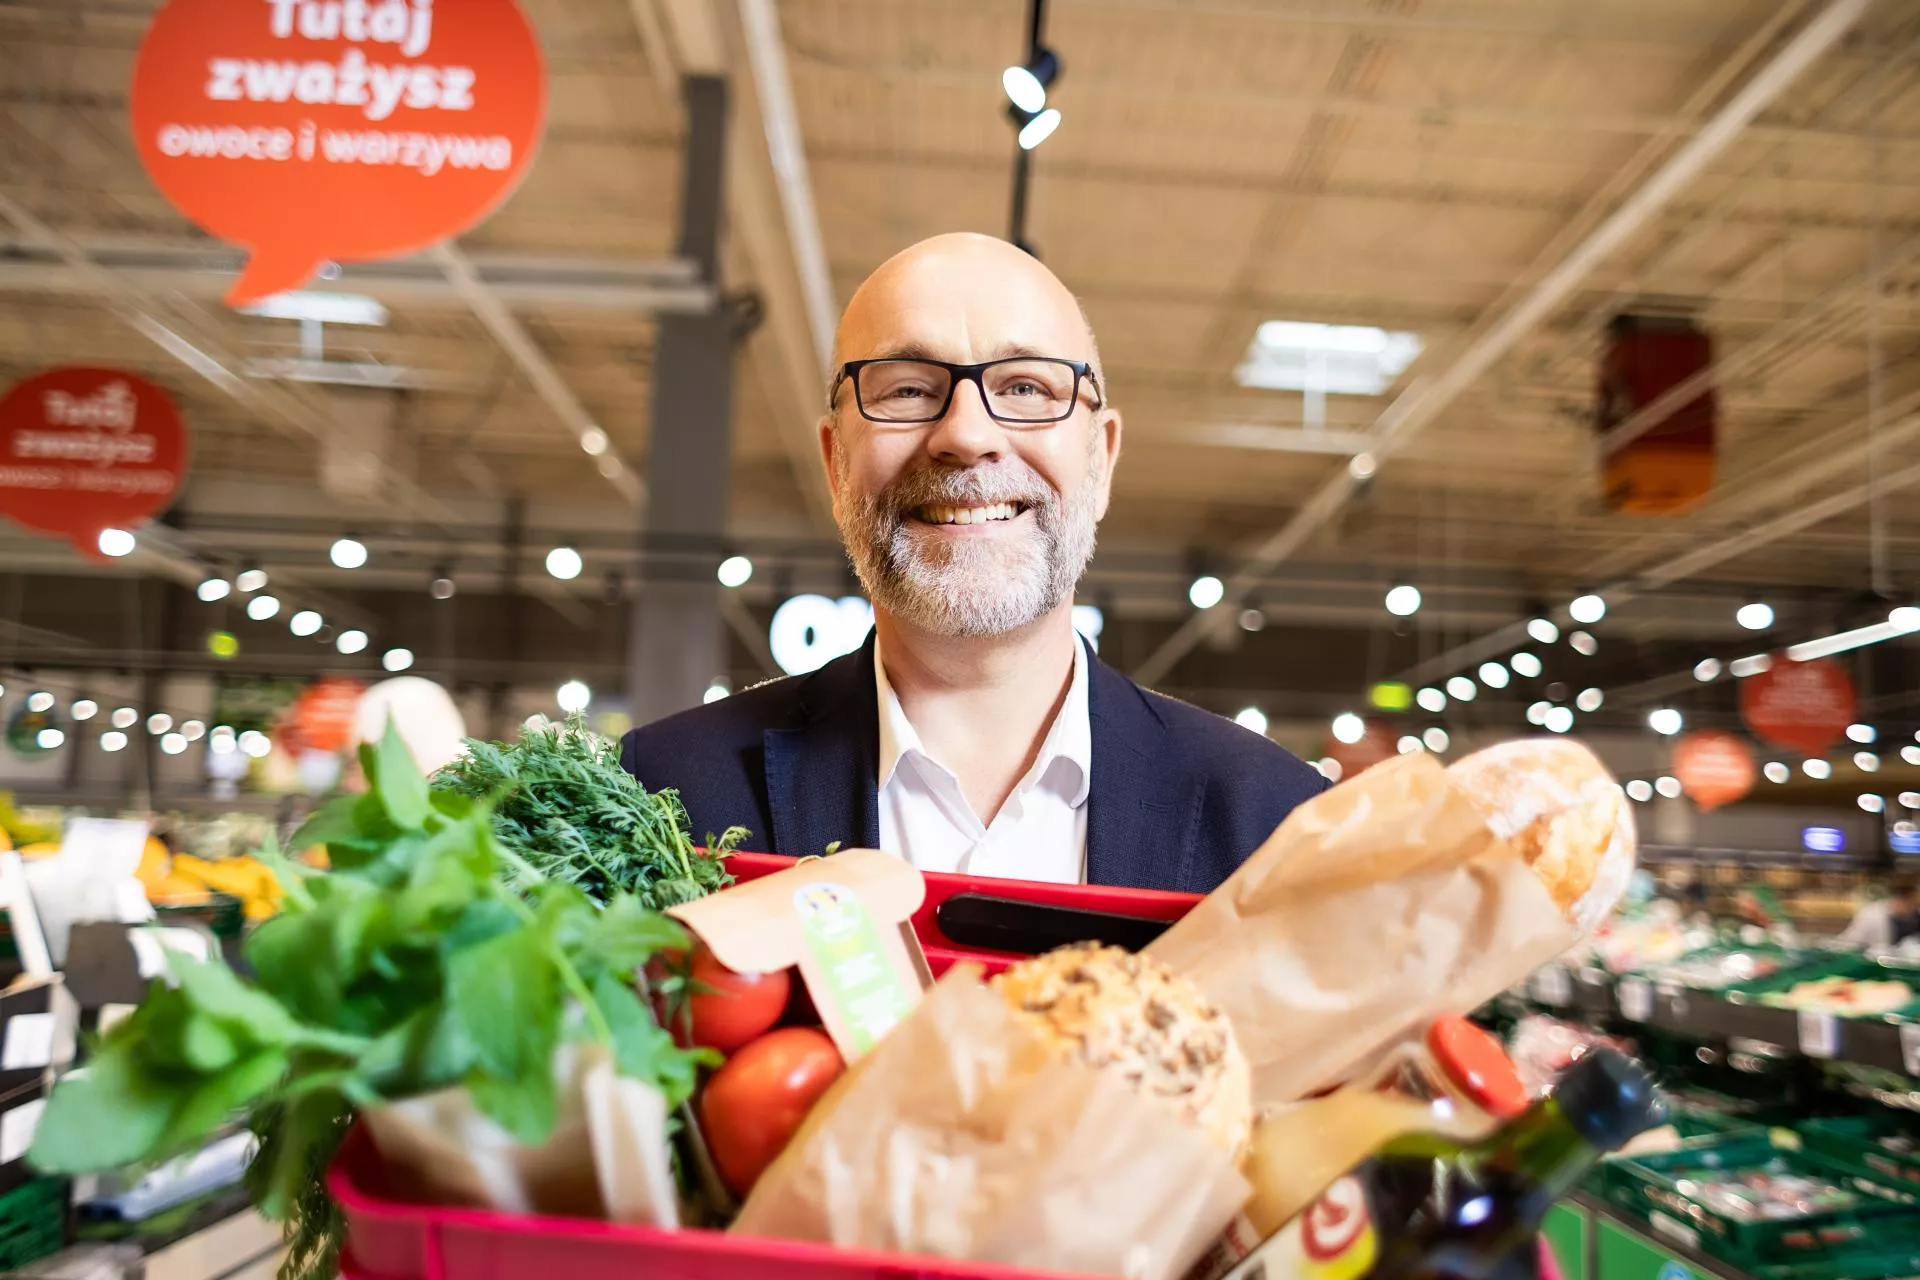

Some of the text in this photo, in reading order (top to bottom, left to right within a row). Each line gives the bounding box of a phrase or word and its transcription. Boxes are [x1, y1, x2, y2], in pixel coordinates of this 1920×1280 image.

[269, 0, 434, 57] Tutaj
[206, 48, 476, 121] zważysz
[158, 119, 513, 177] owoce i warzywa
